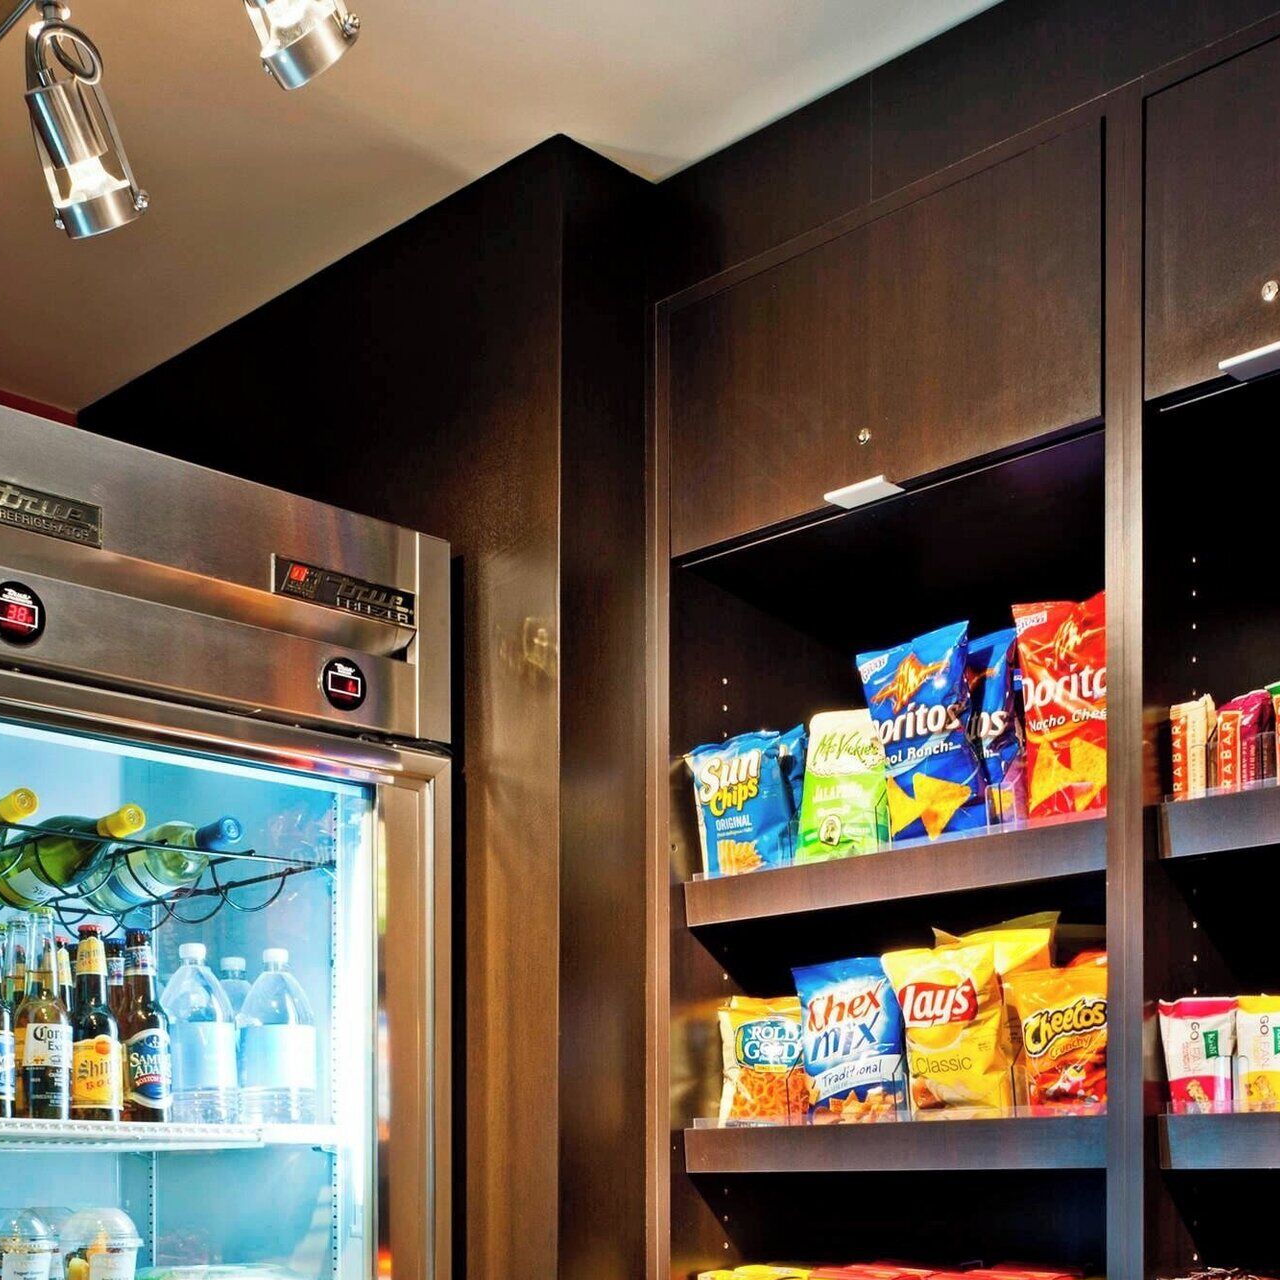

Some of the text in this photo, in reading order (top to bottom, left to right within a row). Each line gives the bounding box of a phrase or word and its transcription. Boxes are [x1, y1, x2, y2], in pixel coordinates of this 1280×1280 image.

[699, 749, 762, 800] Sun
[709, 776, 759, 817] Chips
[715, 814, 753, 829] ORIGINAL
[822, 1061, 883, 1088] Traditional
[915, 1054, 973, 1074] Classic
